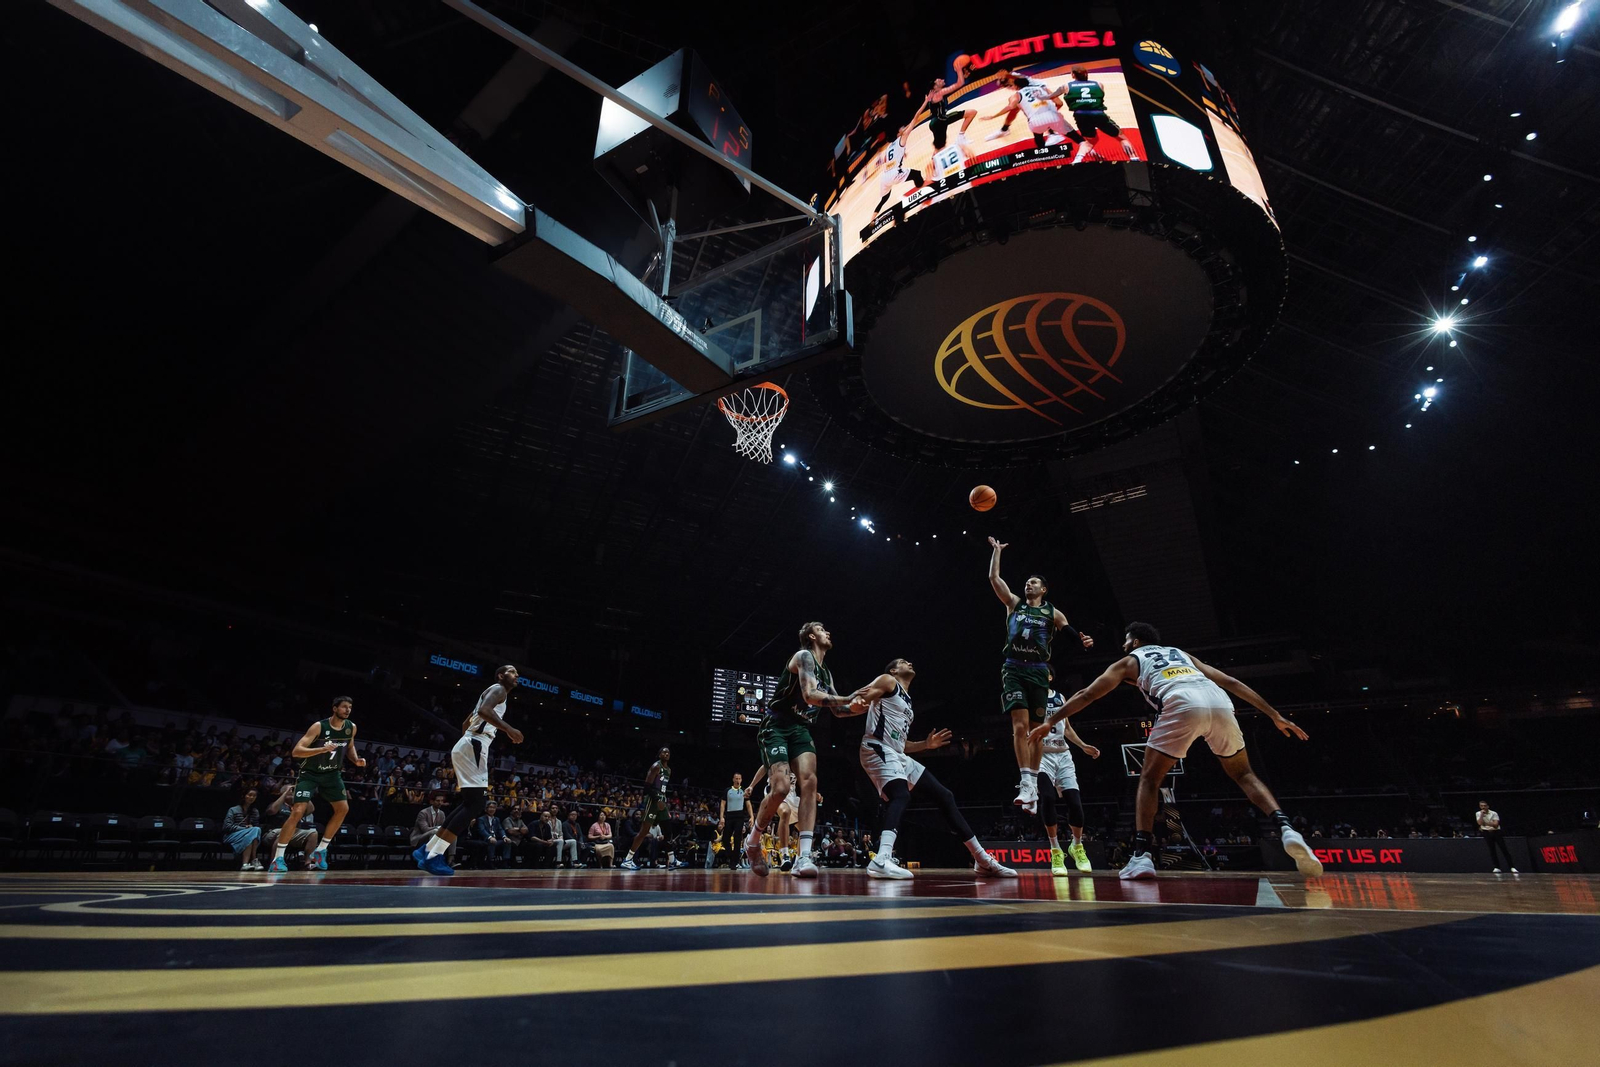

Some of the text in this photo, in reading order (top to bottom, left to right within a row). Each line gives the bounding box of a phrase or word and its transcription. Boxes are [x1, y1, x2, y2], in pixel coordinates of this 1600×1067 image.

[969, 34, 1049, 69] VISIT
[1052, 31, 1100, 49] US
[1080, 87, 1091, 98] 2
[941, 152, 959, 169] 12
[908, 190, 922, 203] UBX
[940, 179, 946, 188] 2
[985, 159, 999, 169] UNI
[429, 654, 478, 675] SÍGUENOS
[1144, 649, 1190, 669] 34
[549, 684, 560, 695] US
[570, 690, 604, 706] SÍGUENOS
[631, 706, 662, 720] FOLLOW US
[330, 750, 337, 760] 7
[1011, 849, 1032, 862] US
[1347, 848, 1376, 863] US
[1380, 848, 1403, 863] AT
